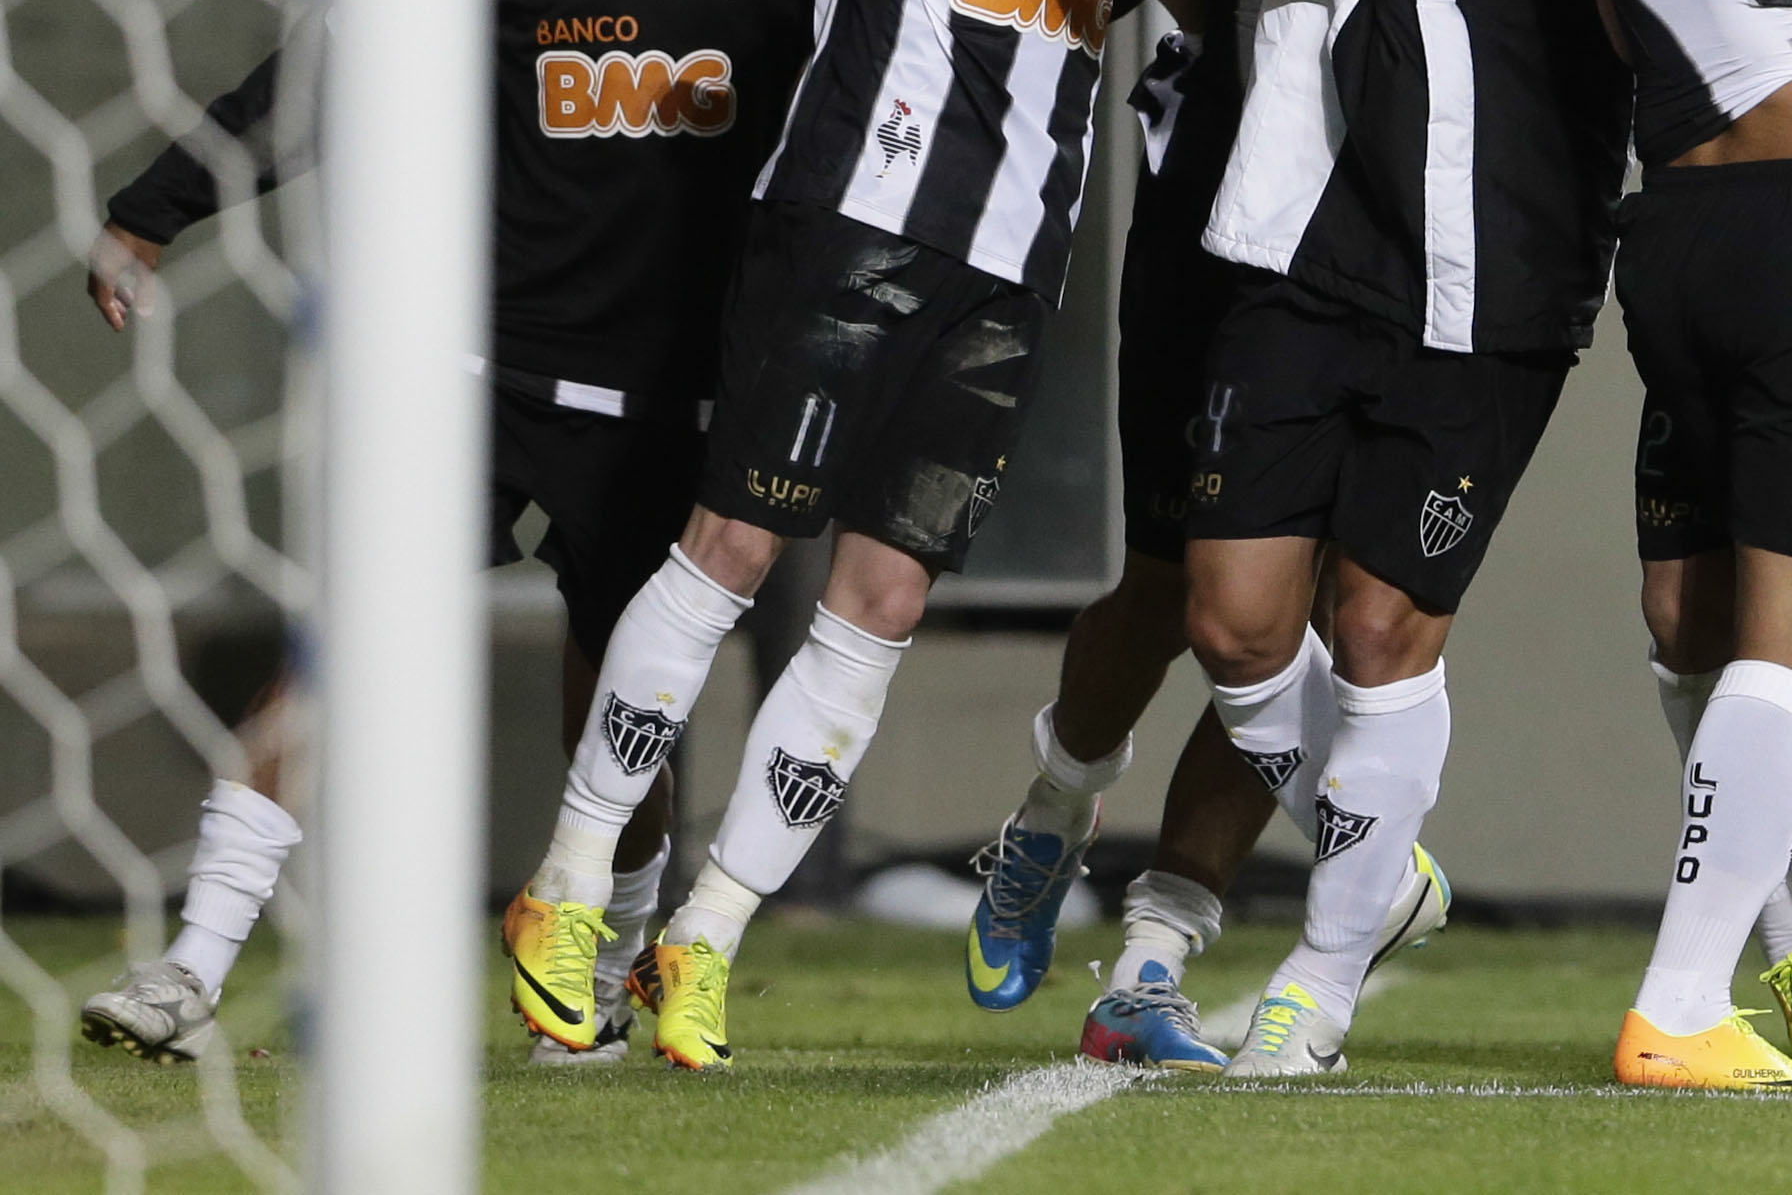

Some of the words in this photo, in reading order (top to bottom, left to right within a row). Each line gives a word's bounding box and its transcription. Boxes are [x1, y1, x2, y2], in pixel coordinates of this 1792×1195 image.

[537, 15, 640, 46] BANCO
[536, 49, 737, 139] BMG
[1433, 500, 1467, 526] CAM
[620, 710, 676, 737] CAM
[788, 763, 844, 798] CAM
[1318, 808, 1354, 830] AM
[1676, 762, 1718, 884] LUPO
